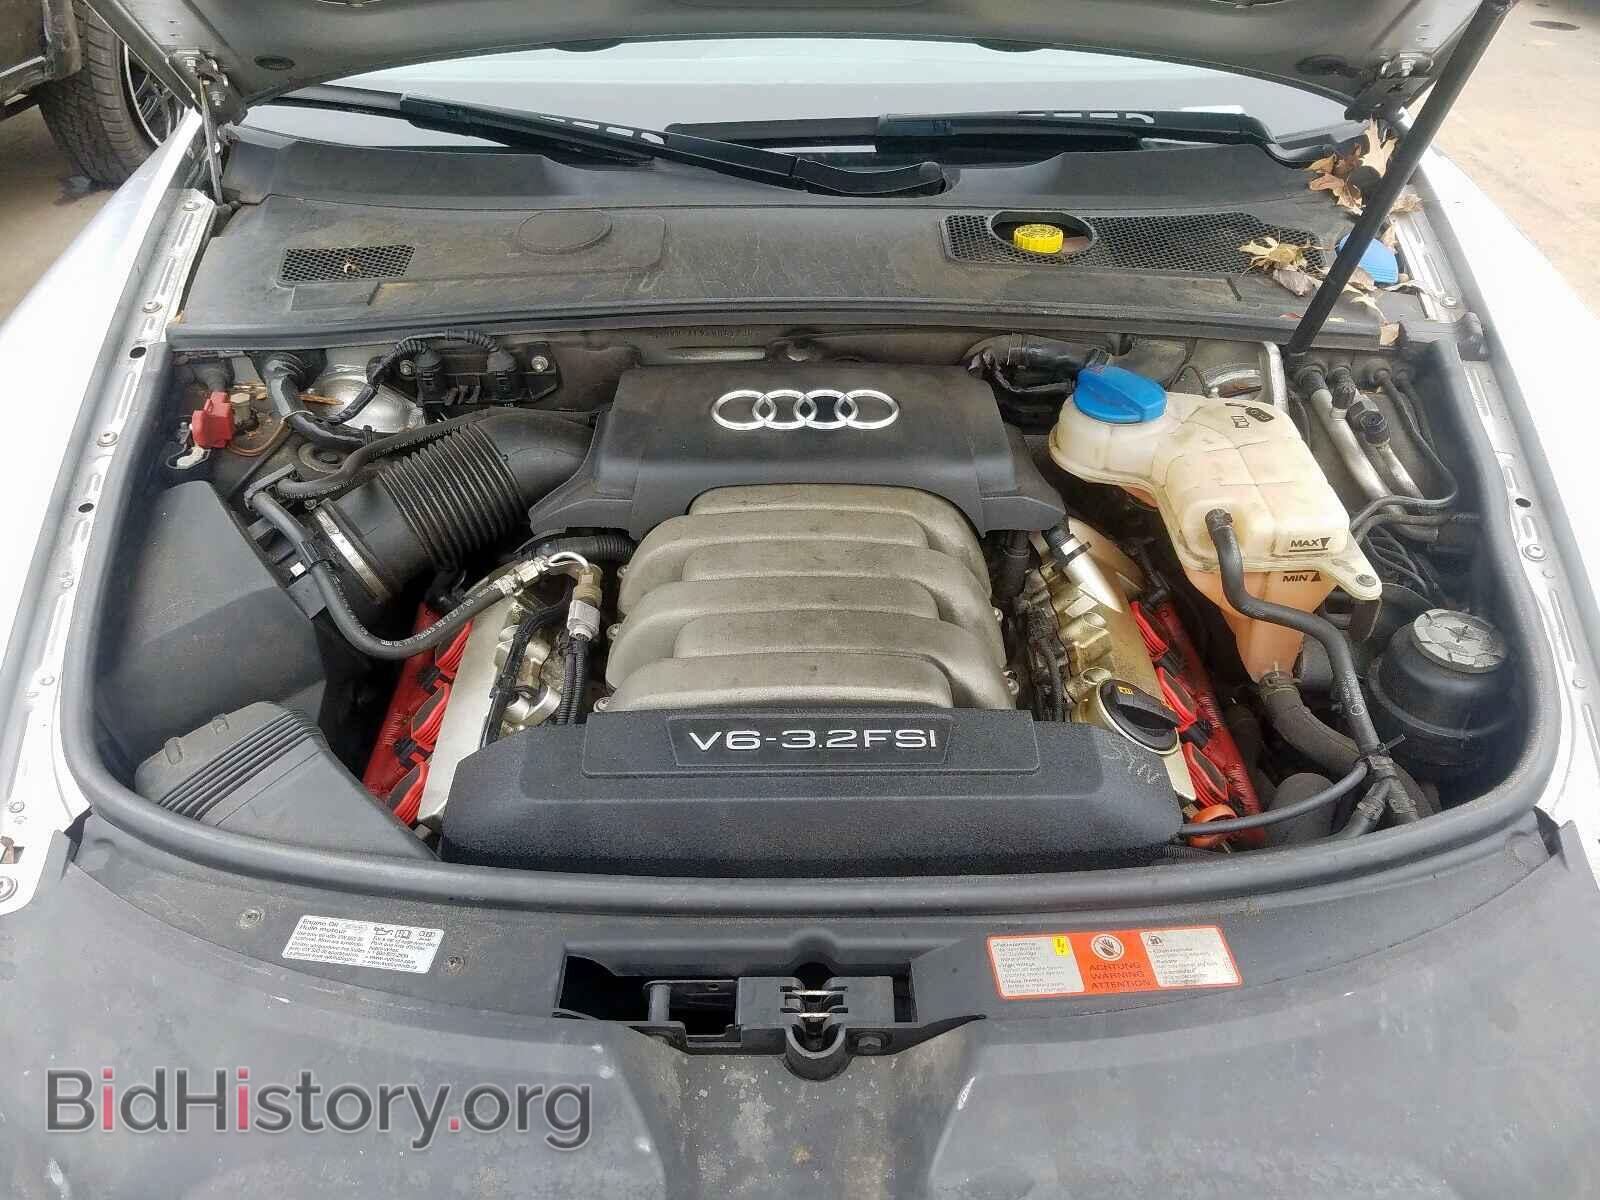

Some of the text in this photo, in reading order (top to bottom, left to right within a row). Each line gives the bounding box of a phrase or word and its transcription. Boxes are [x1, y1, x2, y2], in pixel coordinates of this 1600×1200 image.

[1291, 539, 1319, 547] MAX
[689, 729, 937, 751] V6-3.2FSI
[1090, 962, 1141, 970] ACHTUNG
[1090, 971, 1144, 979] WARNING
[1091, 979, 1151, 989] ATTENTION
